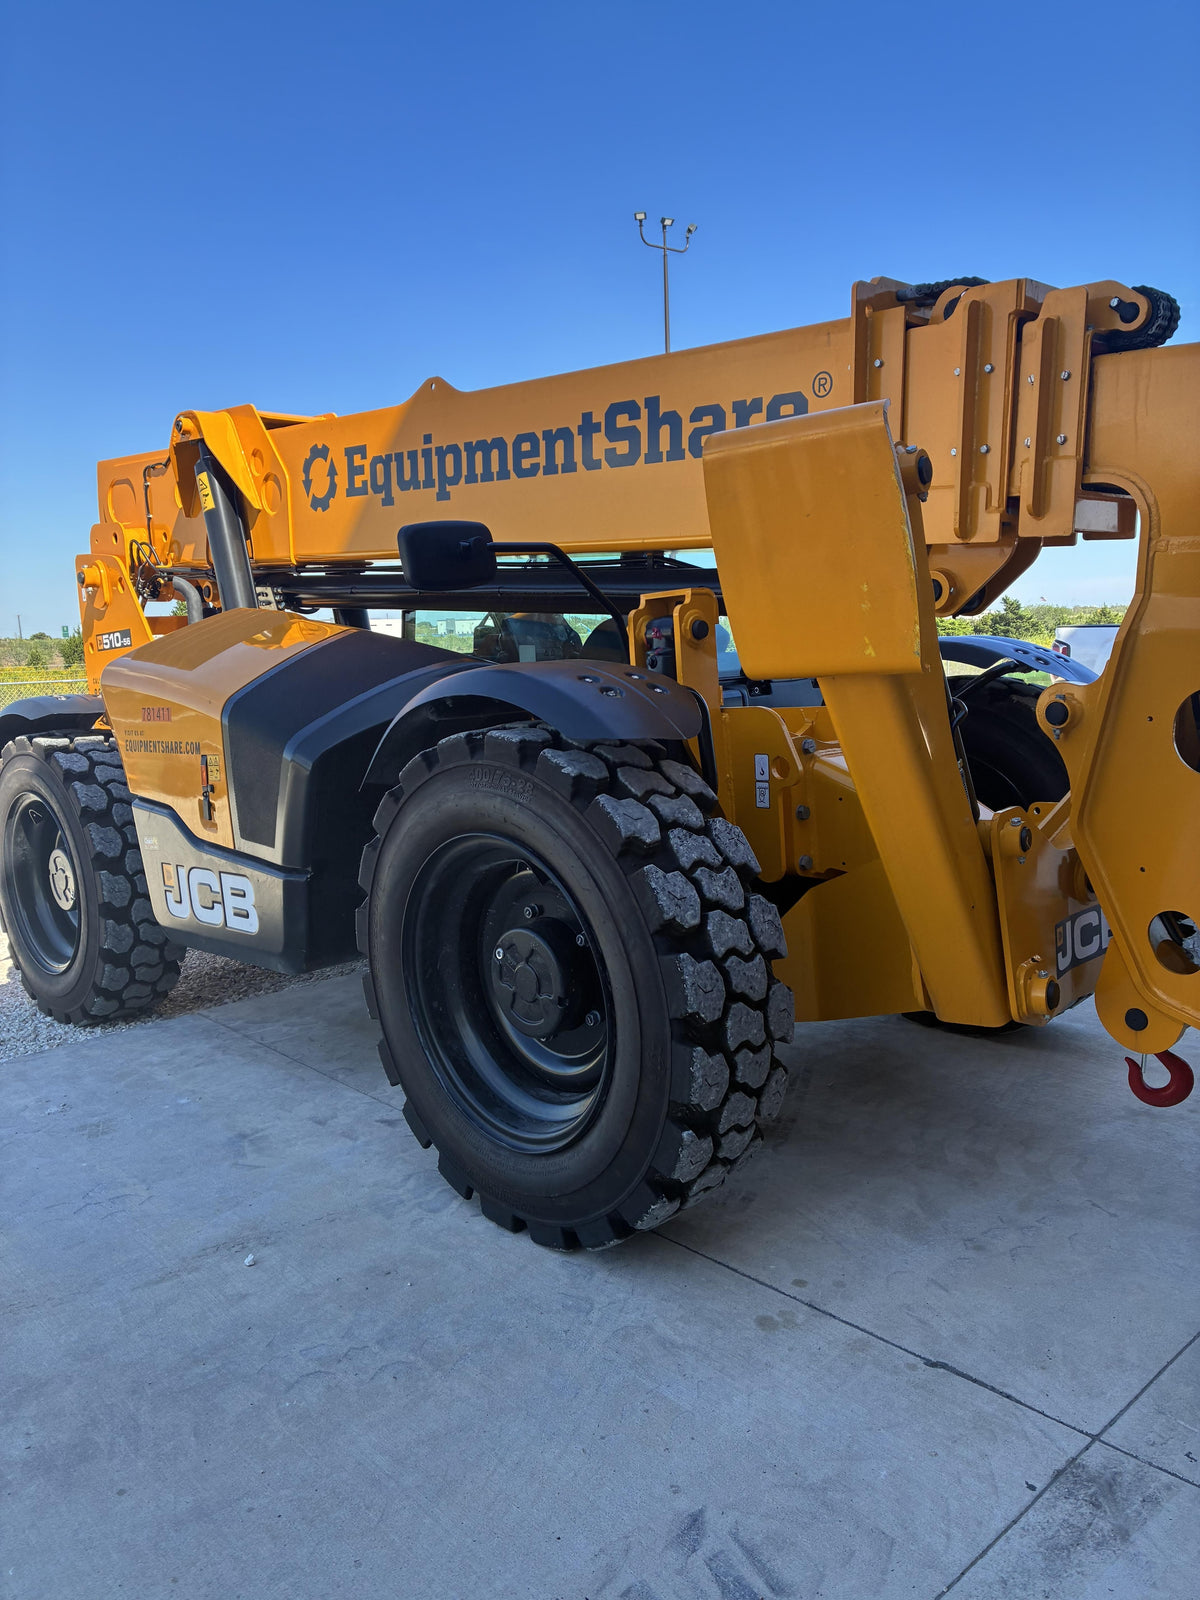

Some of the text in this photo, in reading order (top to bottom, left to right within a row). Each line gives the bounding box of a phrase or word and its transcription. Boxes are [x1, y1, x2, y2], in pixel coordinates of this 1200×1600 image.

[142, 707, 170, 721] 781411
[125, 740, 200, 755] EQUIPMENTSHARE.COM
[161, 862, 259, 935] JCB
